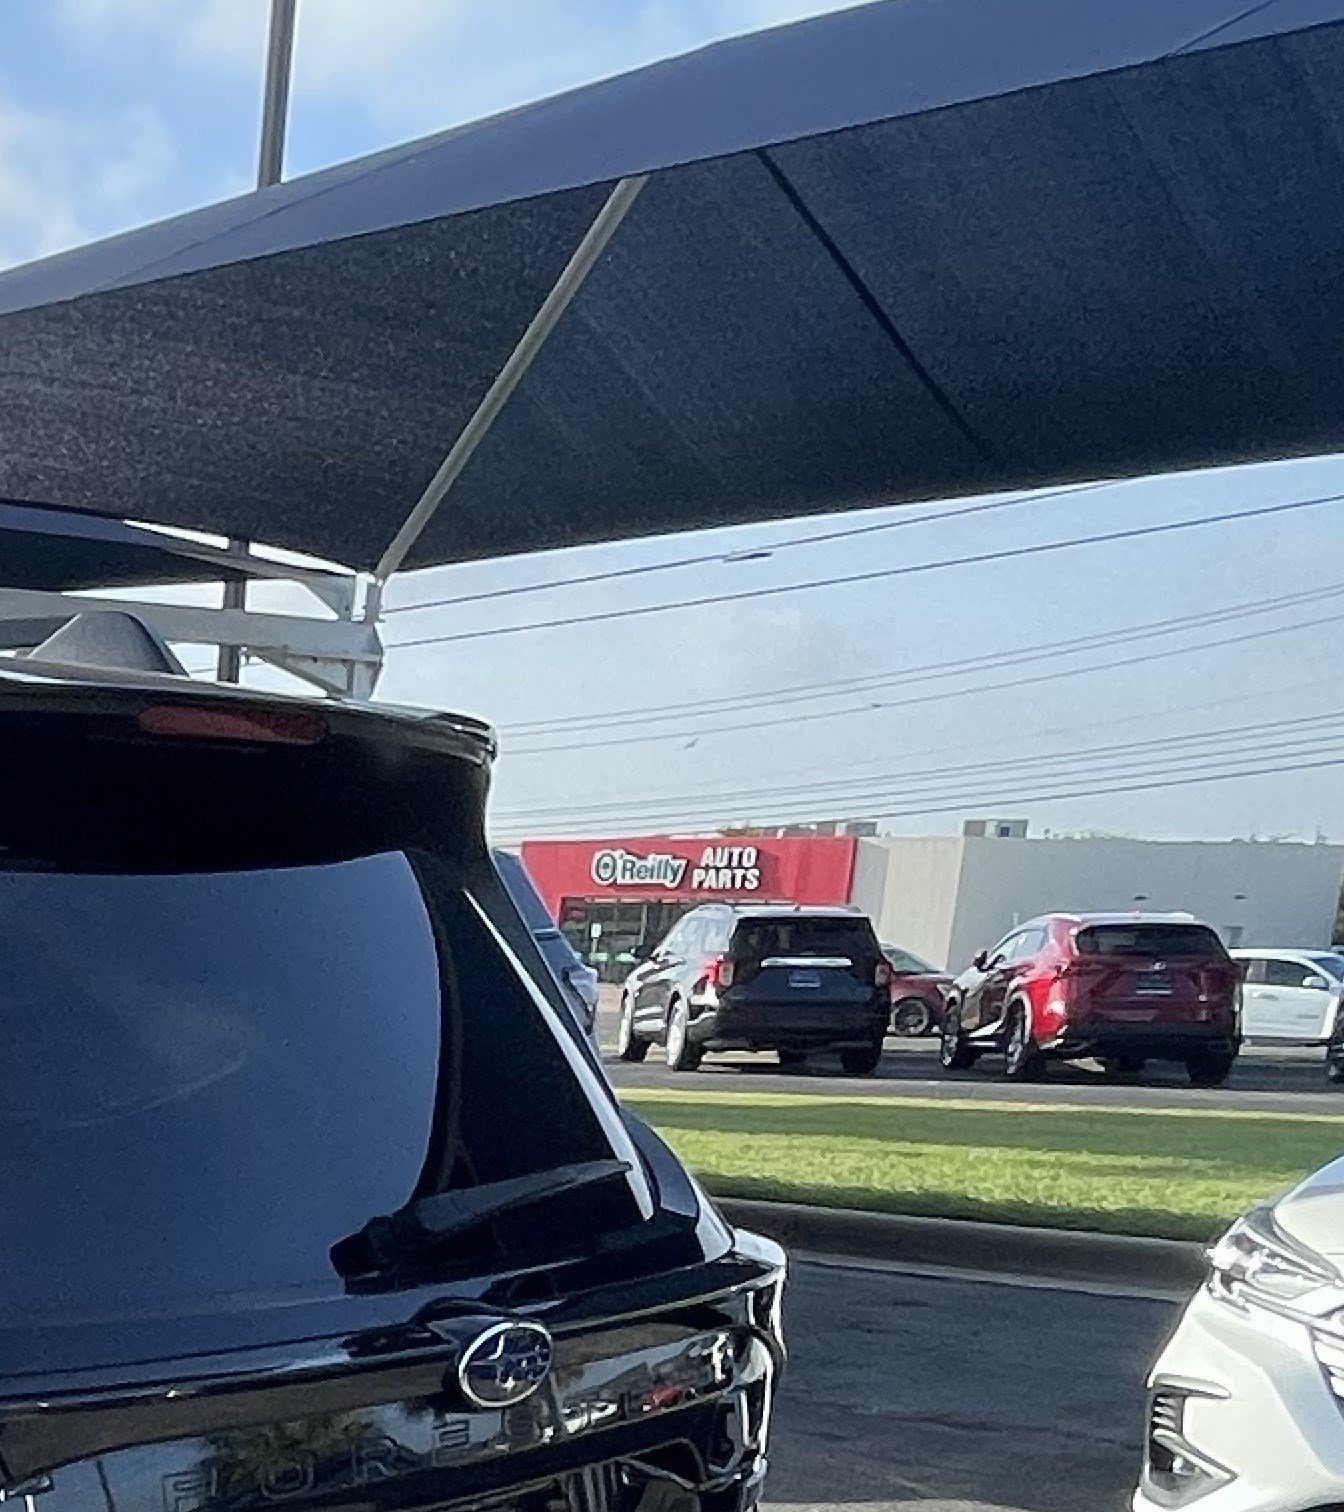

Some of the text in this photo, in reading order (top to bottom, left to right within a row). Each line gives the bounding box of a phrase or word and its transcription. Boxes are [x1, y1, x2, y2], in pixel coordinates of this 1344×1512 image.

[700, 846, 757, 868] AUTO
[594, 851, 686, 887] O'Reilly
[692, 868, 759, 889] PARTS
